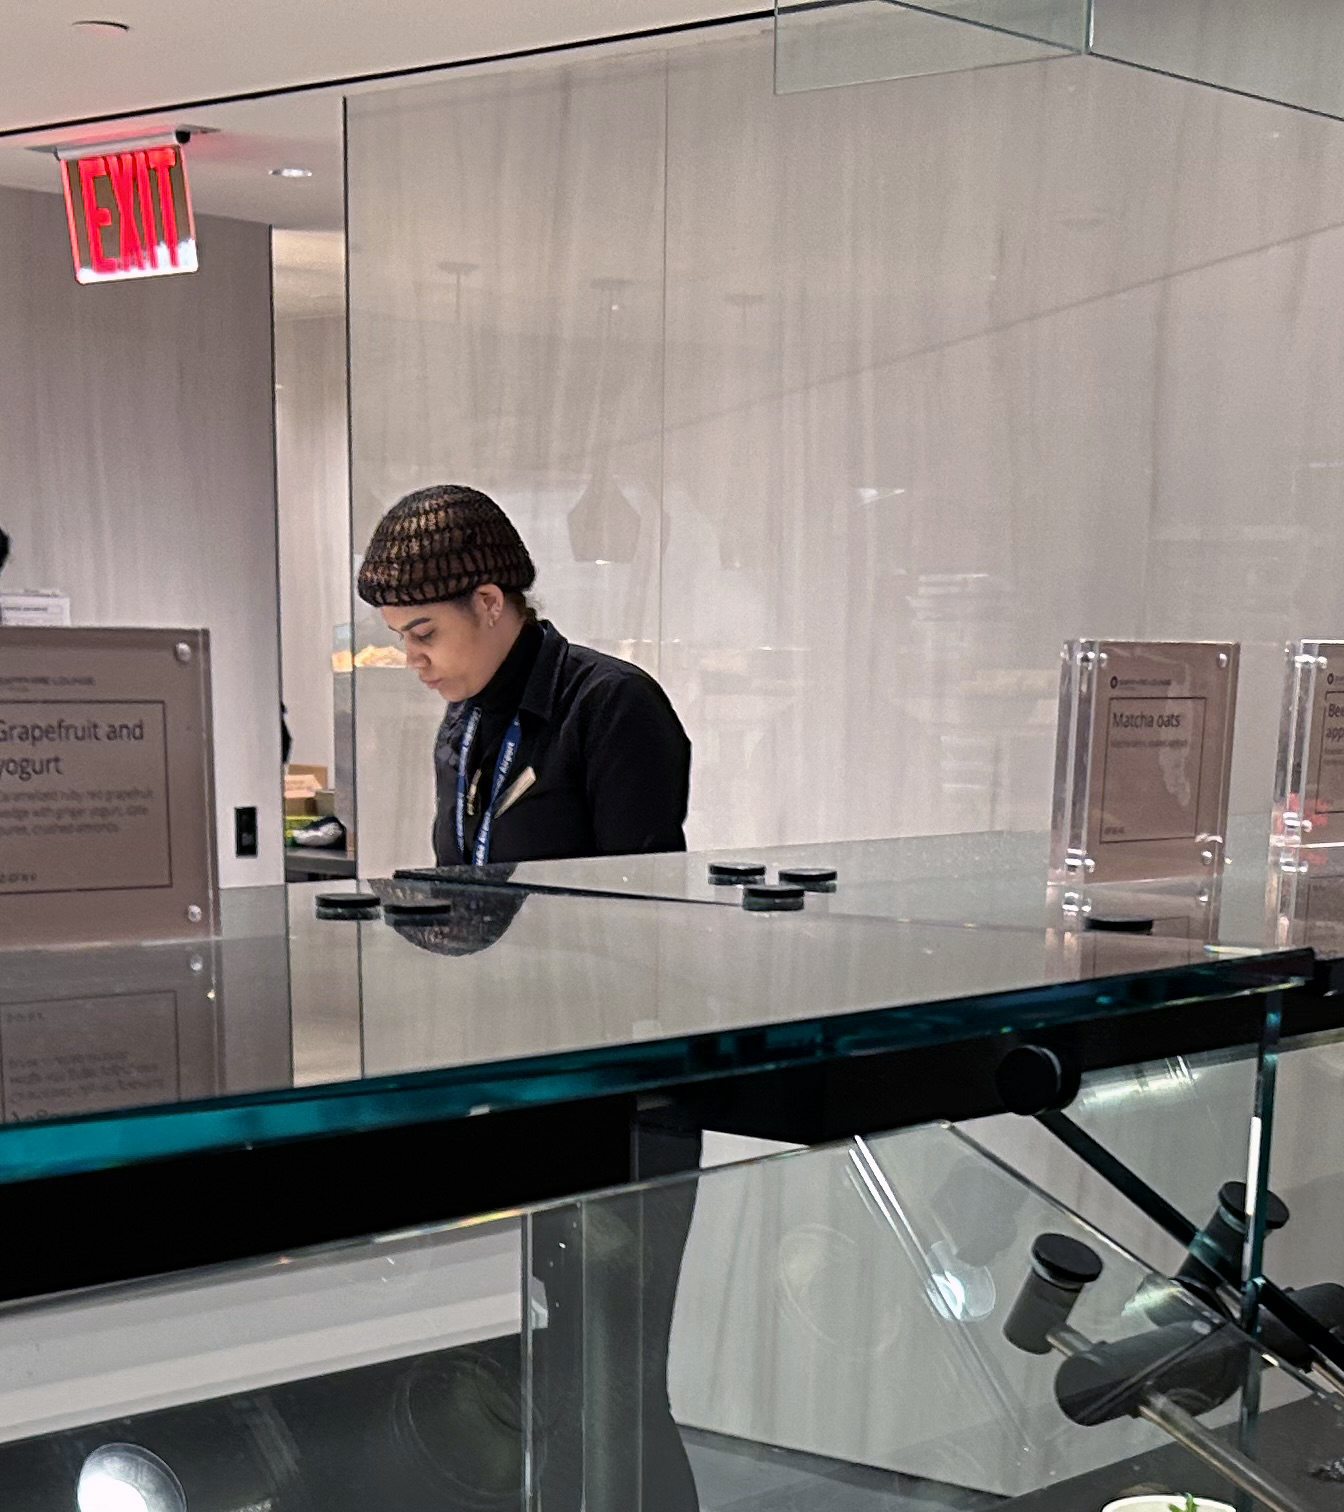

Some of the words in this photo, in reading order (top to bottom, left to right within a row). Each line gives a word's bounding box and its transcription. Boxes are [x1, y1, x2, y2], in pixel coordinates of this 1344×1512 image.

[77, 147, 179, 273] EXIT
[106, 718, 144, 741] and
[1112, 711, 1154, 728] Matcha
[1156, 713, 1181, 728] oats
